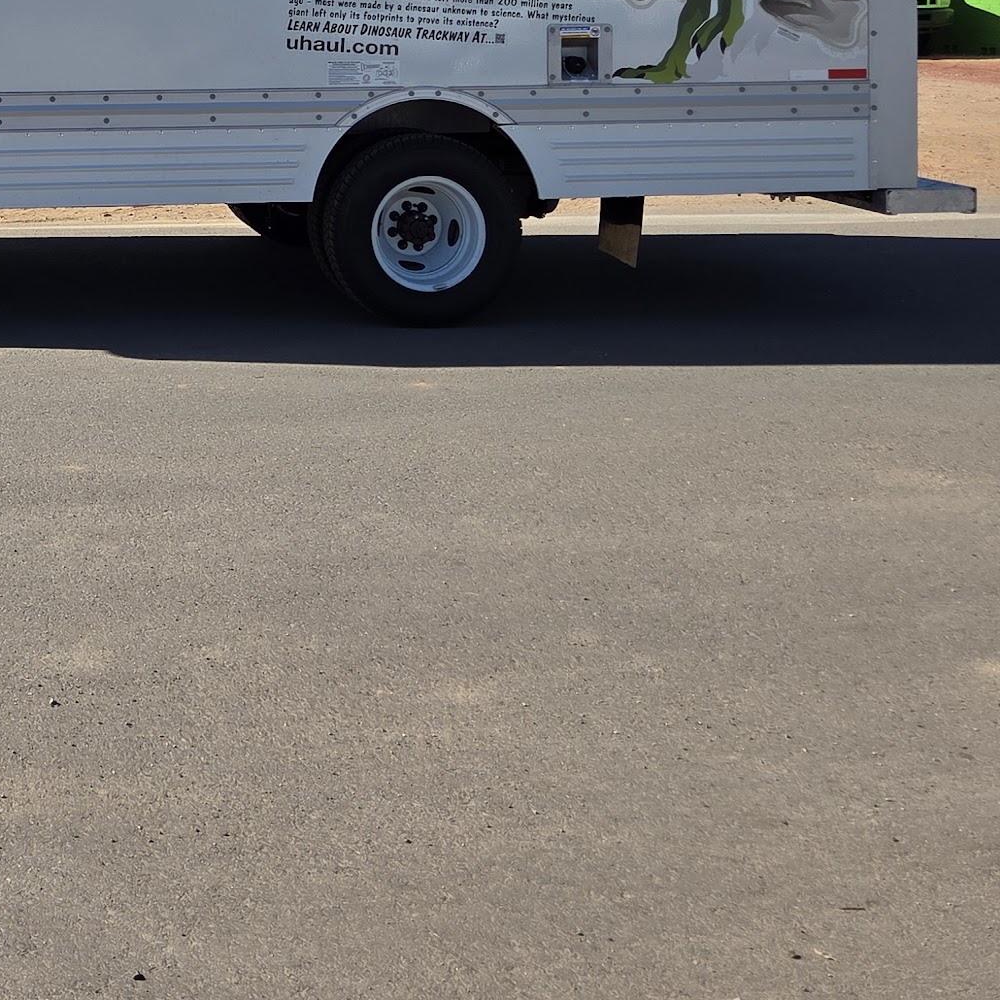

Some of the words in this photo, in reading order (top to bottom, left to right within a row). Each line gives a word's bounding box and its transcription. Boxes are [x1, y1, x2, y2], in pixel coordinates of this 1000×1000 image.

[338, 0, 357, 8] were
[360, 0, 382, 9] made
[384, 1, 394, 12] by
[405, 2, 440, 13] dinosaur
[442, 5, 477, 16] unknown
[480, 7, 489, 17] to
[491, 8, 524, 19] science.
[527, 10, 549, 20] What
[551, 13, 596, 23] mysterious
[520, 0, 548, 9] million
[551, 2, 573, 10] years
[288, 7, 309, 18] giant
[312, 8, 327, 18] left
[329, 10, 347, 21] only
[349, 10, 360, 20] its
[363, 11, 404, 23] footprints
[406, 14, 415, 23] to
[418, 16, 440, 25] prove
[443, 16, 453, 26] its
[456, 18, 499, 29] existence?
[287, 19, 321, 32] LEARN
[322, 21, 359, 35] ABOUT
[360, 23, 412, 39] DINOSAUR
[415, 27, 470, 42] TRACKWAY
[286, 35, 399, 56] uhaul.com
